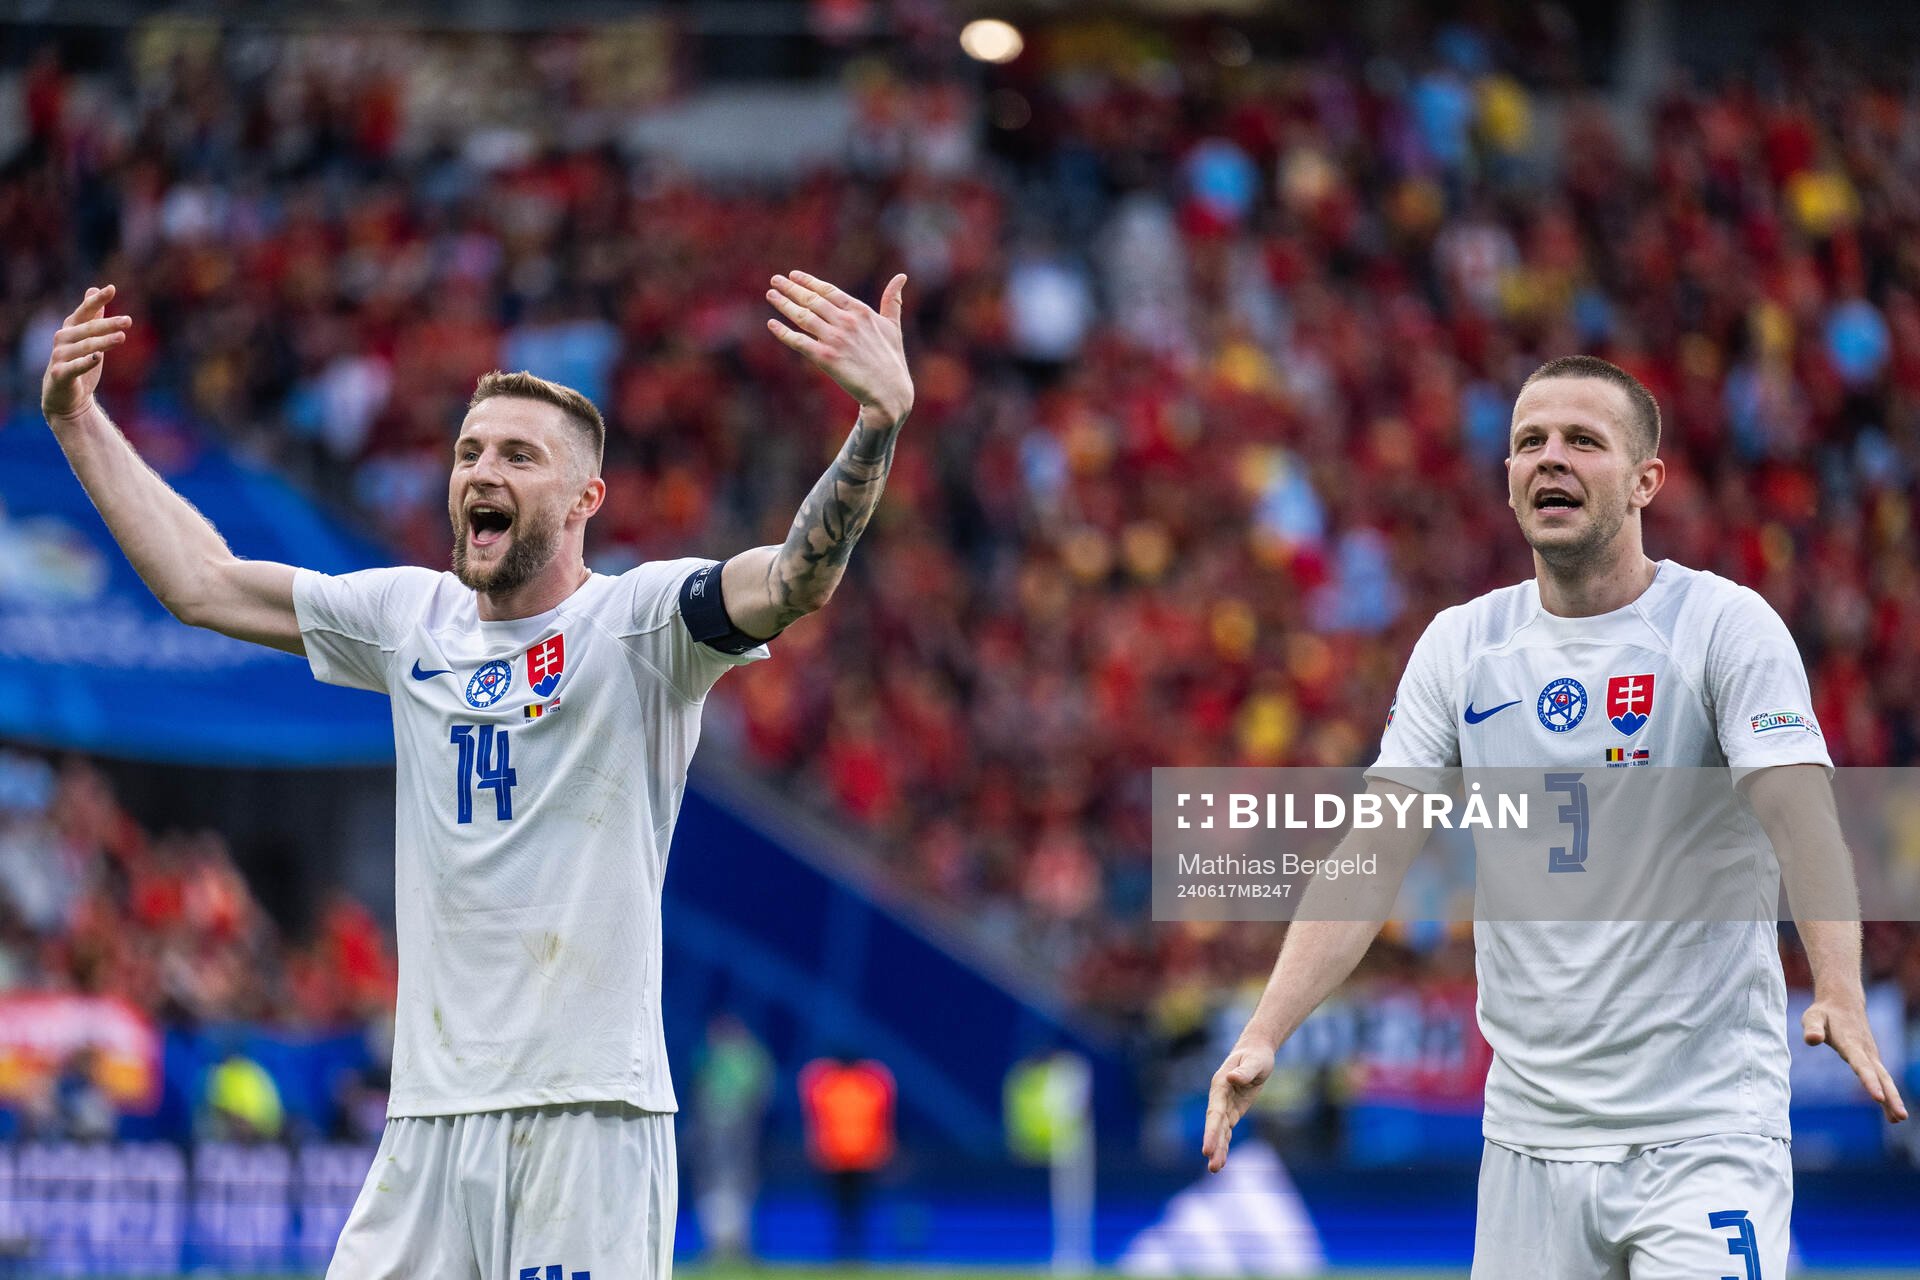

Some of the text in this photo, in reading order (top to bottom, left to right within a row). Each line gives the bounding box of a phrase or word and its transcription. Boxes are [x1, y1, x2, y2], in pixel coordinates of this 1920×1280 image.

[1750, 712, 1769, 721] UEFA
[450, 725, 518, 824] 14
[1544, 772, 1590, 873] 3
[1708, 1210, 1763, 1280] 3
